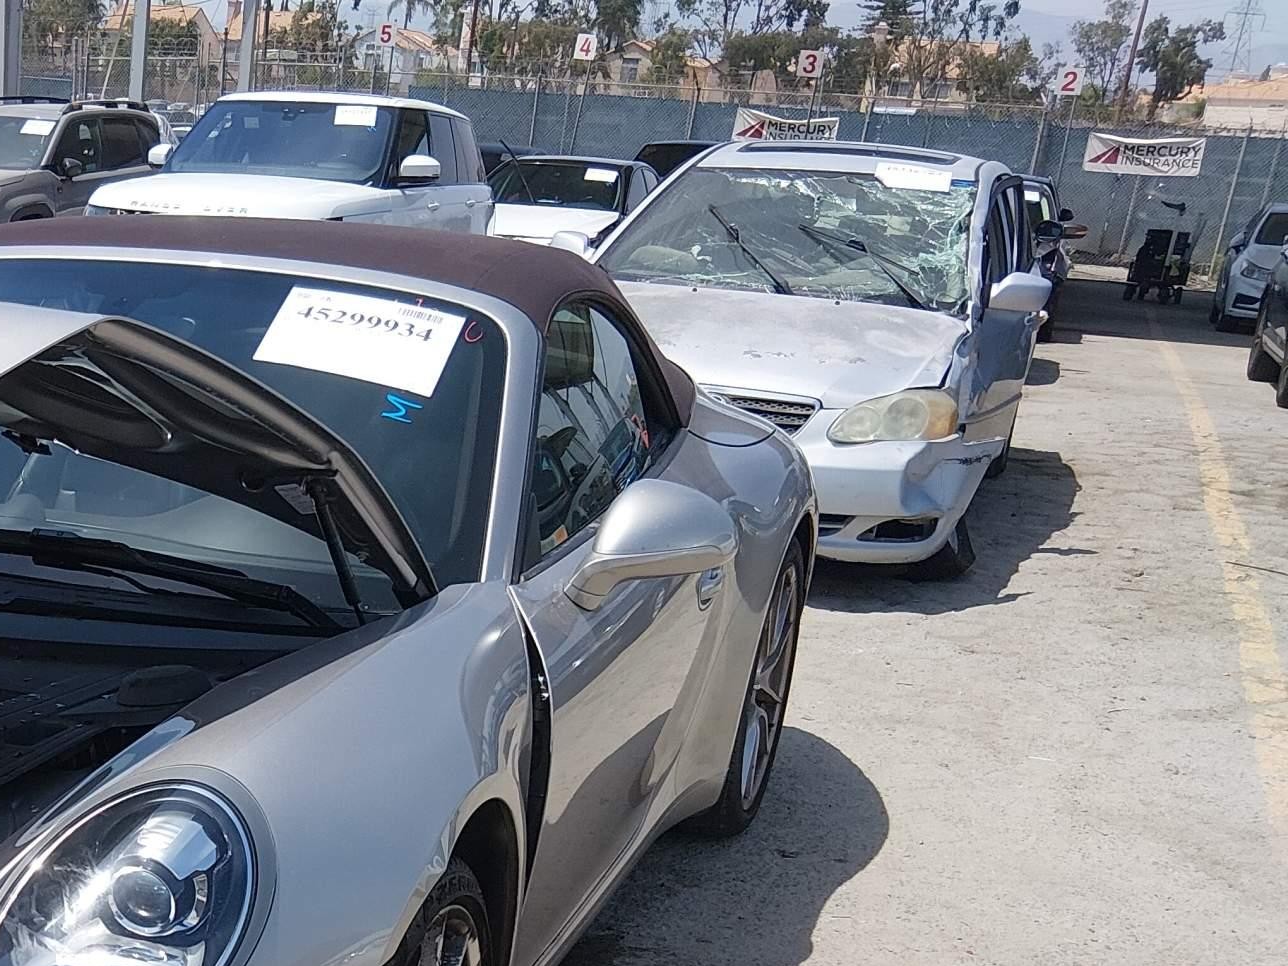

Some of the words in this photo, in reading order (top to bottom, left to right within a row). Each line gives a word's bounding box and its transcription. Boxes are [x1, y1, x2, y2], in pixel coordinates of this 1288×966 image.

[380, 25, 392, 43] 5
[579, 37, 592, 57] 4
[802, 54, 818, 74] 3
[1061, 71, 1078, 91] 2
[767, 120, 836, 136] MERCURY
[1123, 144, 1201, 158] MERCURY
[1120, 155, 1200, 169] INSURANCE
[297, 305, 434, 342] 45299934
